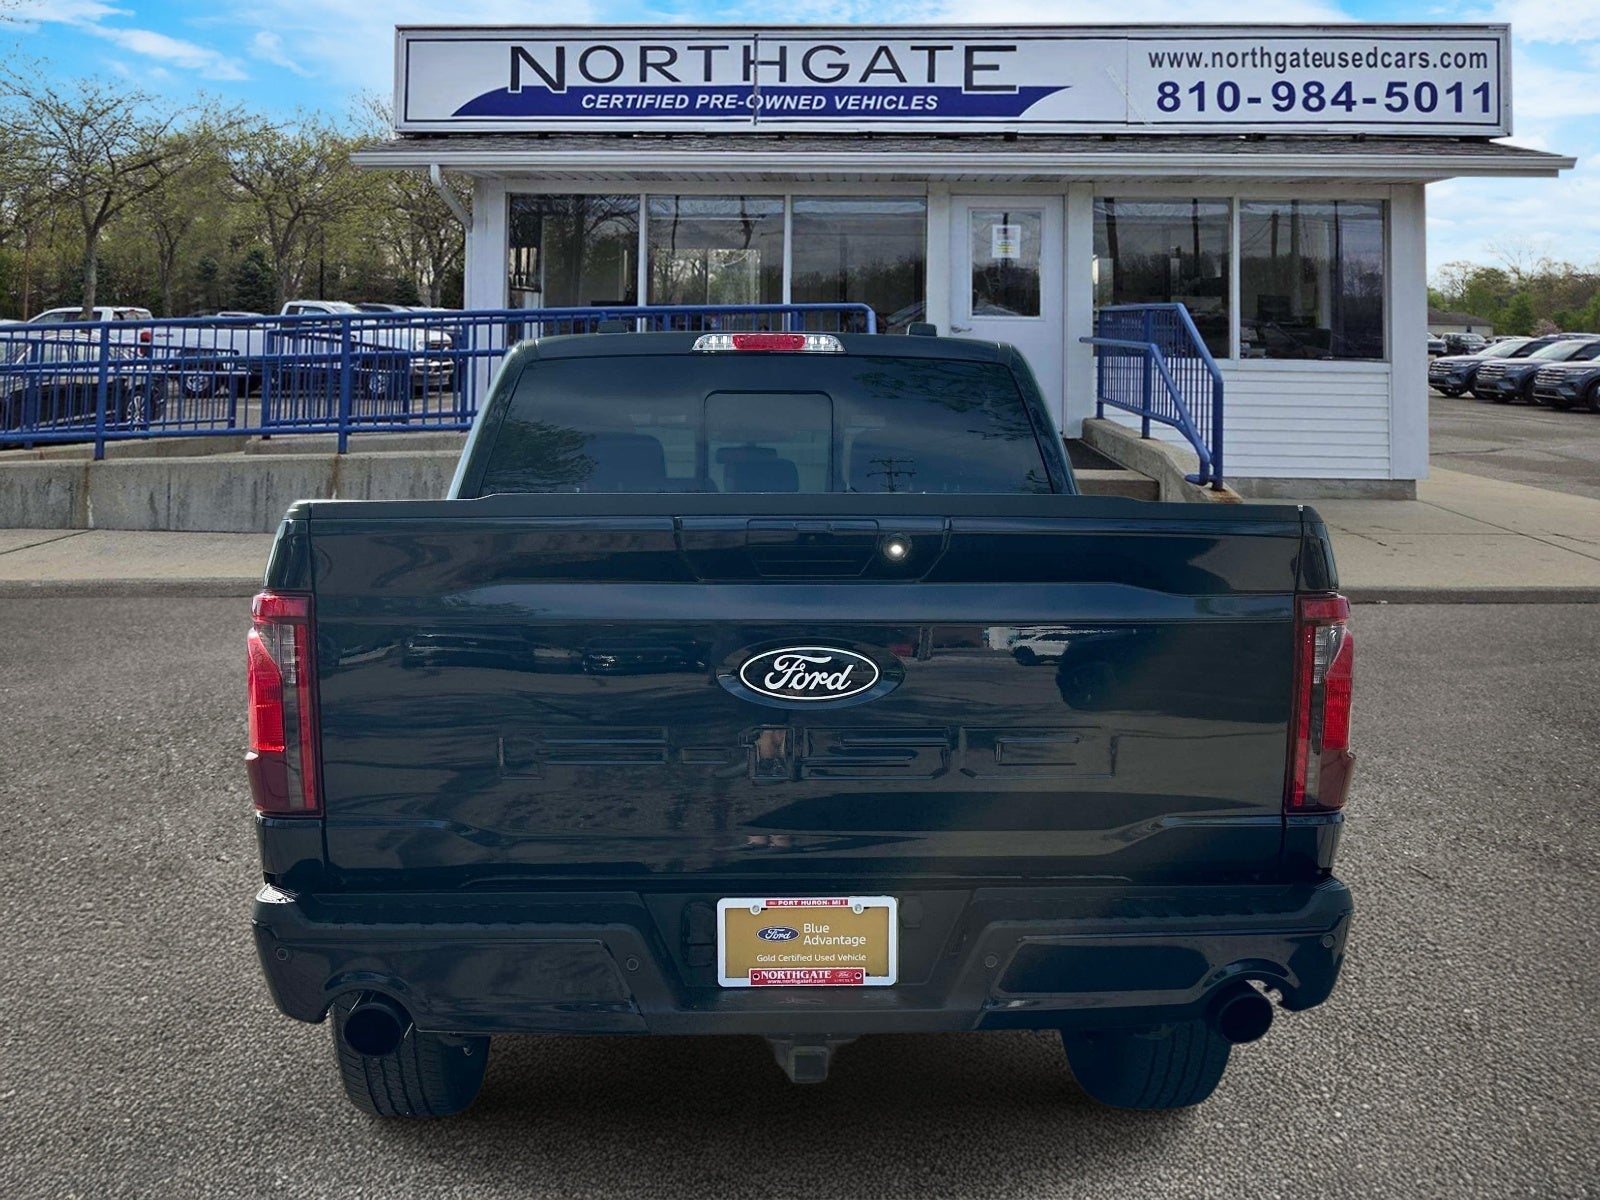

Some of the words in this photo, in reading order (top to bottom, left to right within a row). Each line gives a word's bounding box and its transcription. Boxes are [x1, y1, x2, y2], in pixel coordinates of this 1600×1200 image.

[1148, 46, 1489, 74] www.northgateusedcars.com
[508, 44, 1018, 94] NORTHGATE
[581, 93, 690, 111] CERTIFIED
[695, 94, 827, 111] PRE-OWNED
[832, 95, 939, 111] VEHICLES
[1156, 80, 1492, 113] 810-984-5011
[764, 654, 854, 691] Ford
[765, 928, 792, 940] Ford
[803, 923, 830, 934] Blue
[803, 935, 867, 947] Advantage
[756, 954, 776, 962] Gold
[778, 953, 812, 962] Certified
[814, 953, 835, 962] Used
[838, 953, 867, 962] Vehicle
[760, 970, 832, 980] NORTHGATE
